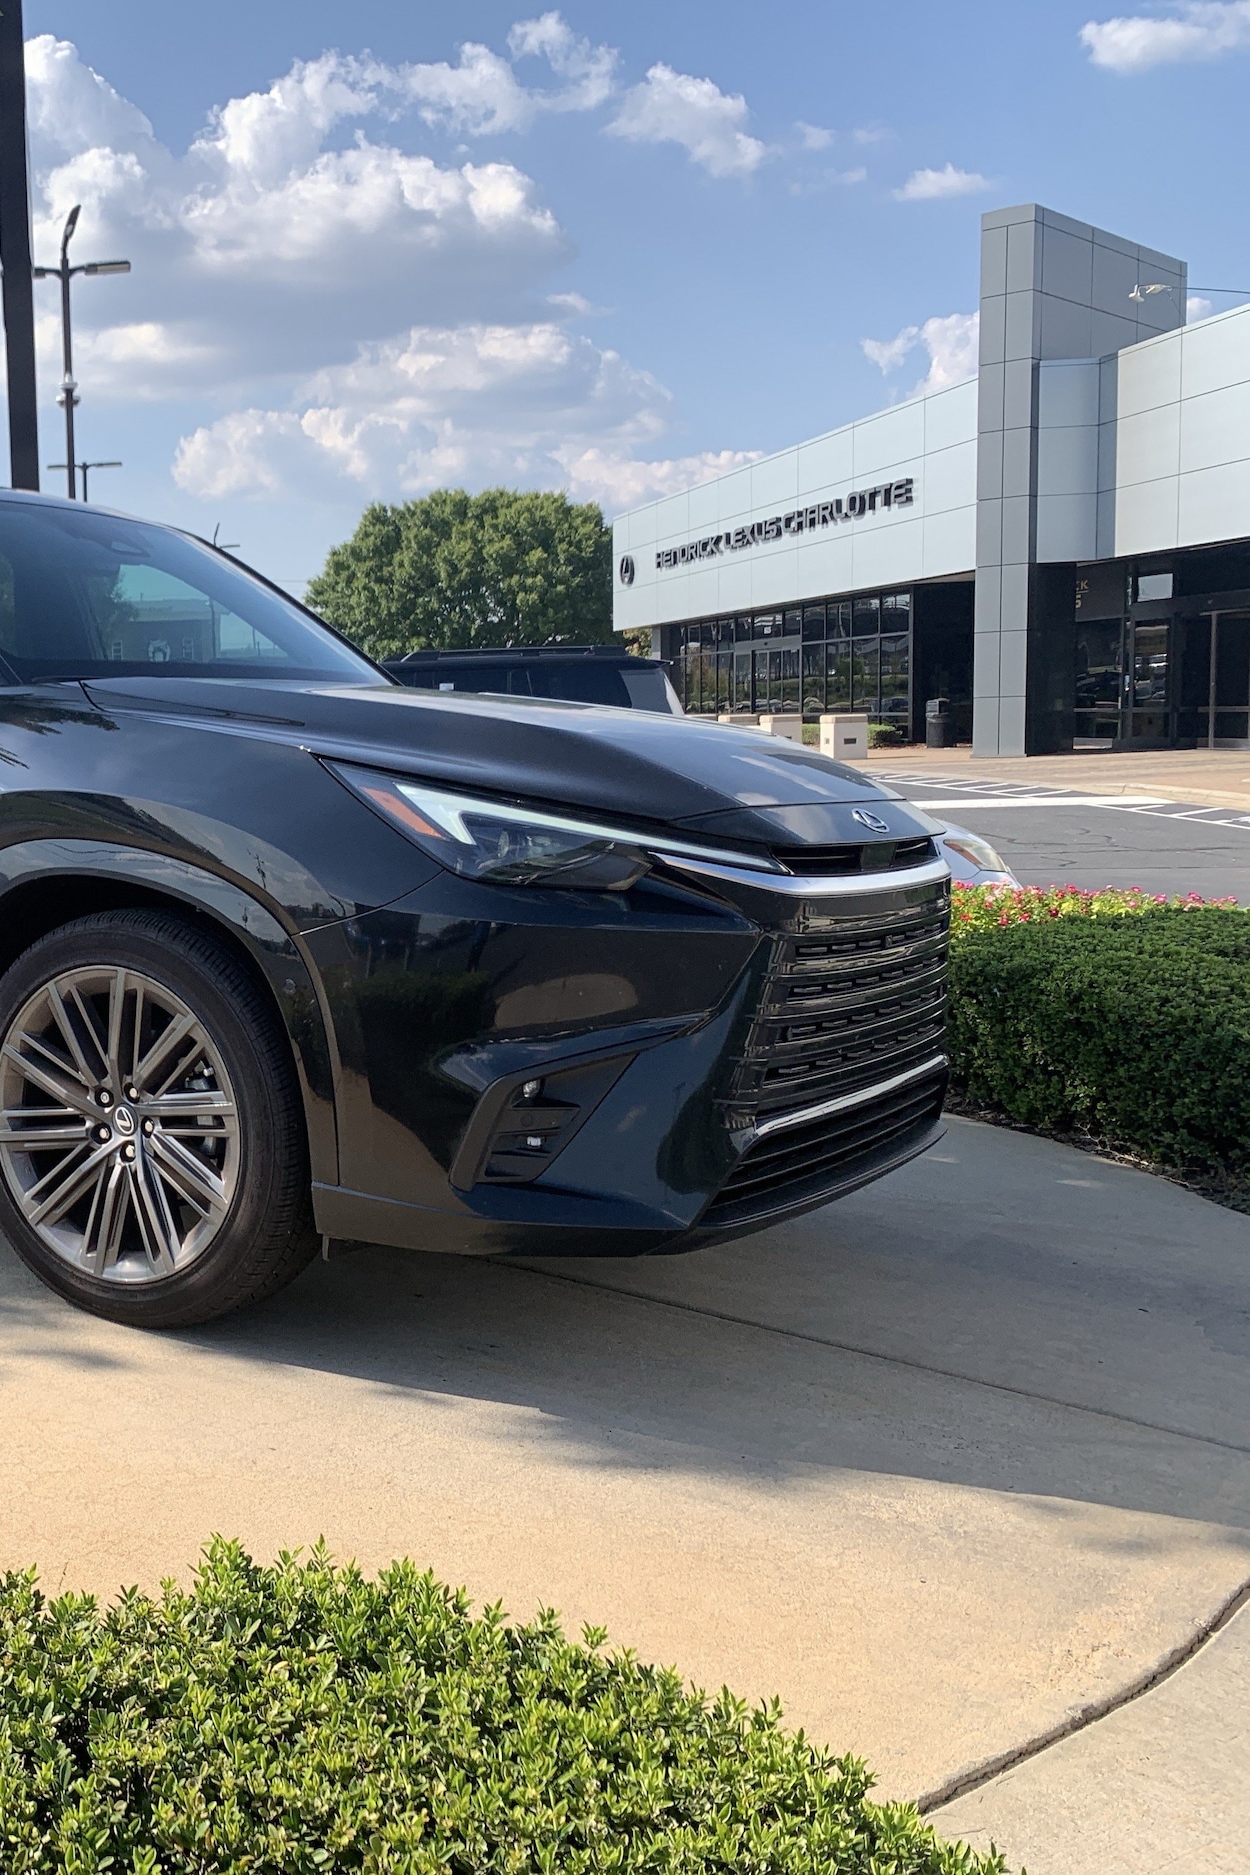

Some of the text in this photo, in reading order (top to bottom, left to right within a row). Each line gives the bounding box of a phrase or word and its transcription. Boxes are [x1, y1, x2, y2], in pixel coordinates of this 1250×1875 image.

[655, 478, 913, 569] HENDRICK LEXUS CHARLOTTE
